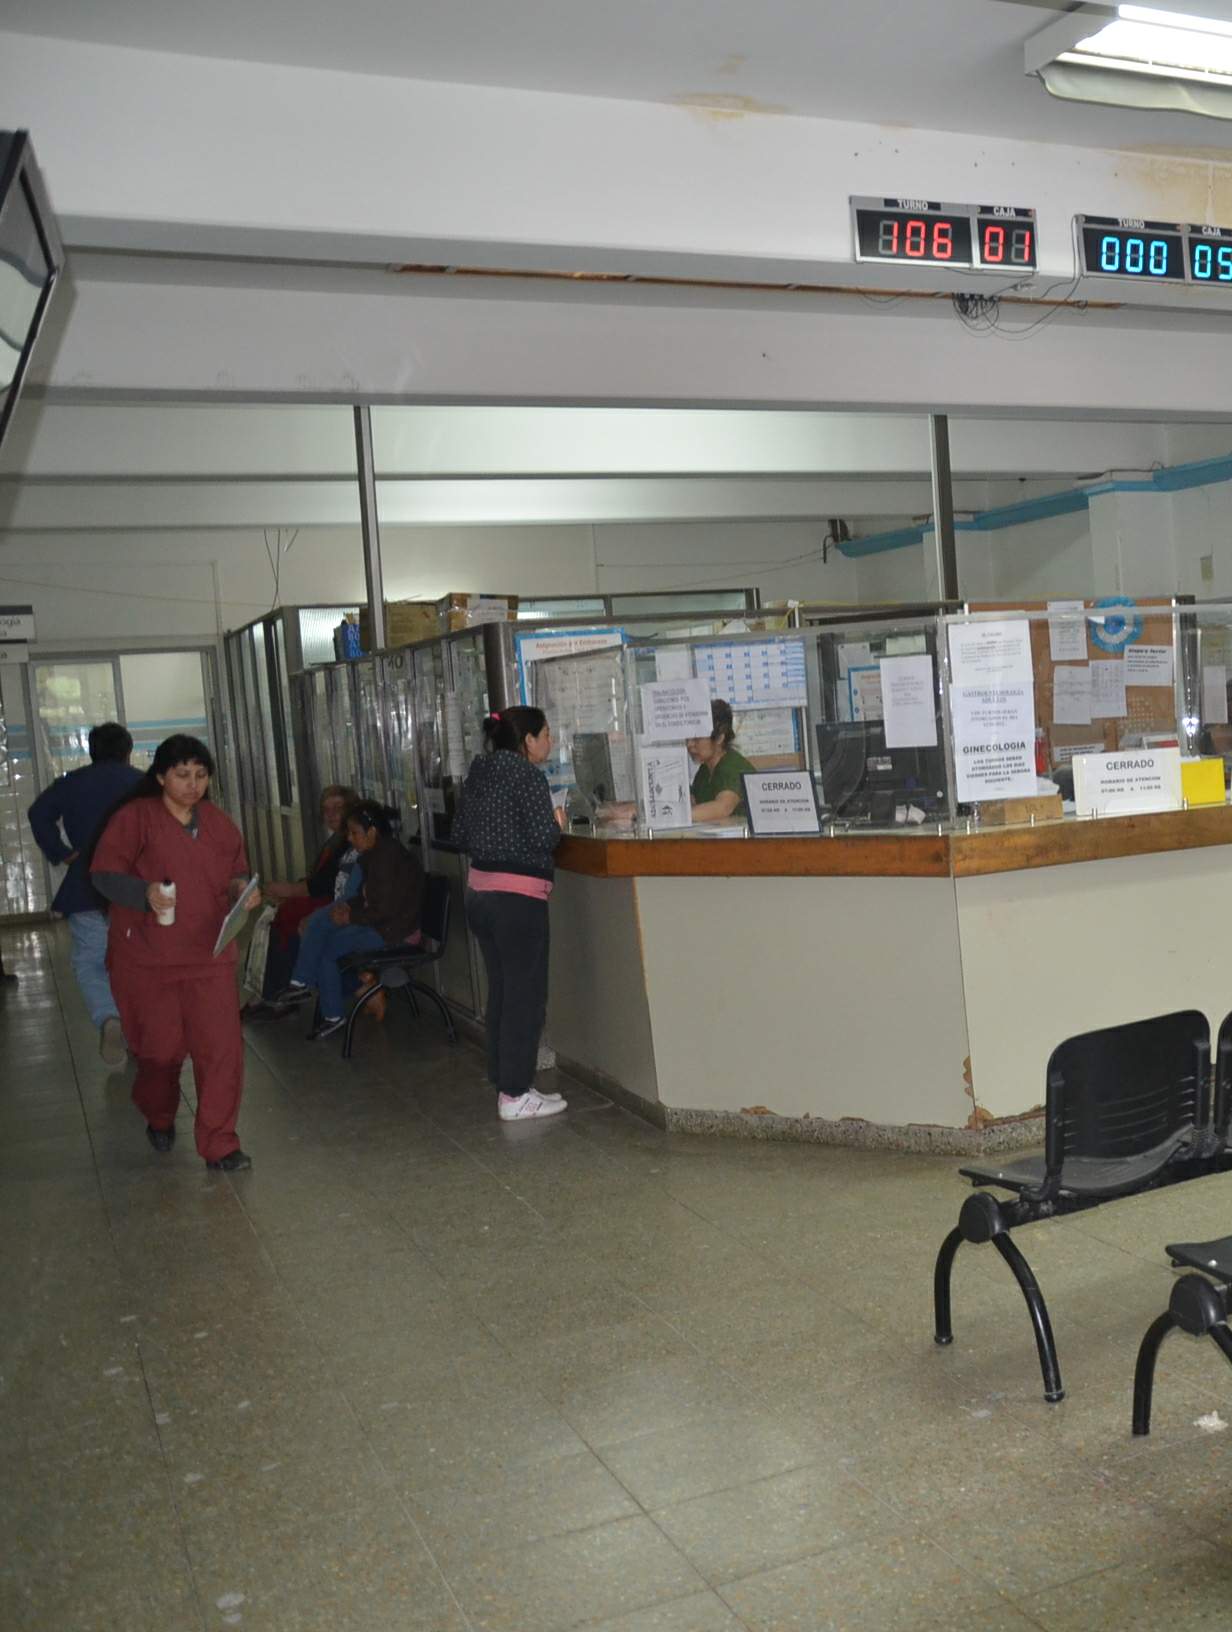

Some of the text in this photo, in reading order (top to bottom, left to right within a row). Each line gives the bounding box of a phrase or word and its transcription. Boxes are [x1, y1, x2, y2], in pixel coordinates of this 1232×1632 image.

[897, 199, 928, 211] TURNO
[993, 206, 1016, 217] CAJA
[1118, 217, 1145, 229] TURNO
[1202, 226, 1222, 237] CAJA
[890, 220, 953, 259] 106
[984, 226, 1031, 263] 01
[1101, 236, 1168, 276] 000
[962, 741, 1026, 754] GINECOLOGIA
[1106, 759, 1154, 771] CERRADO
[761, 781, 802, 792] CERRADO
